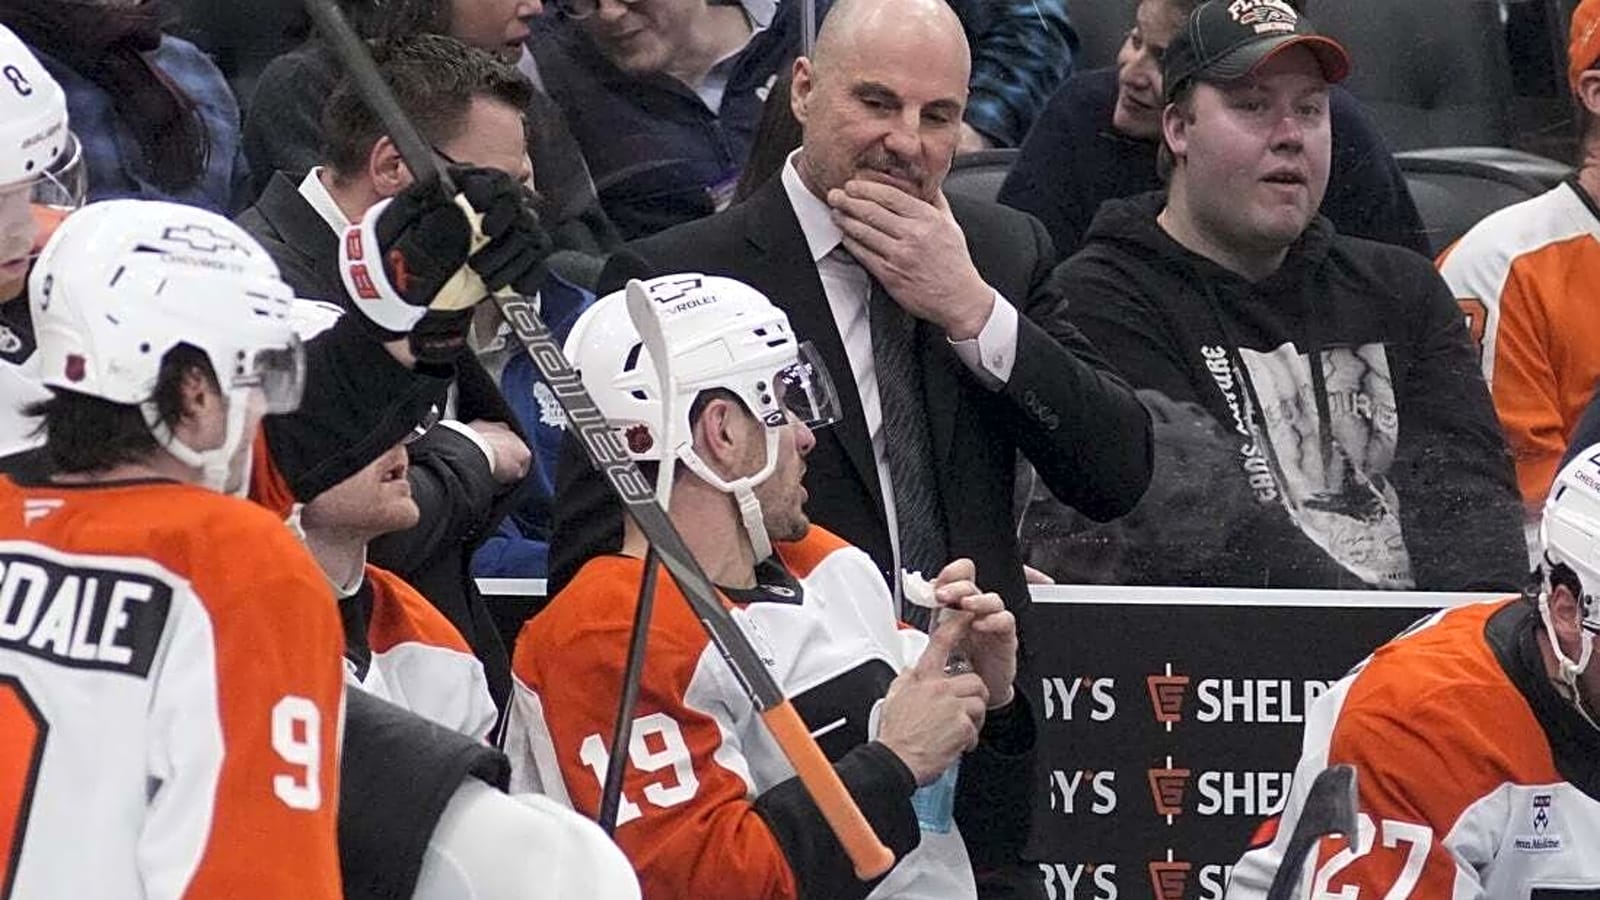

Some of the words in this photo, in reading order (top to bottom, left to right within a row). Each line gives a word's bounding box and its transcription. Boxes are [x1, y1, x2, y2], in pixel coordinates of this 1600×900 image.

[0, 561, 153, 665] DALE
[271, 695, 322, 812] 9
[579, 711, 700, 828] 19
[1049, 770, 1117, 815] Y'S
[1310, 812, 1434, 900] 27
